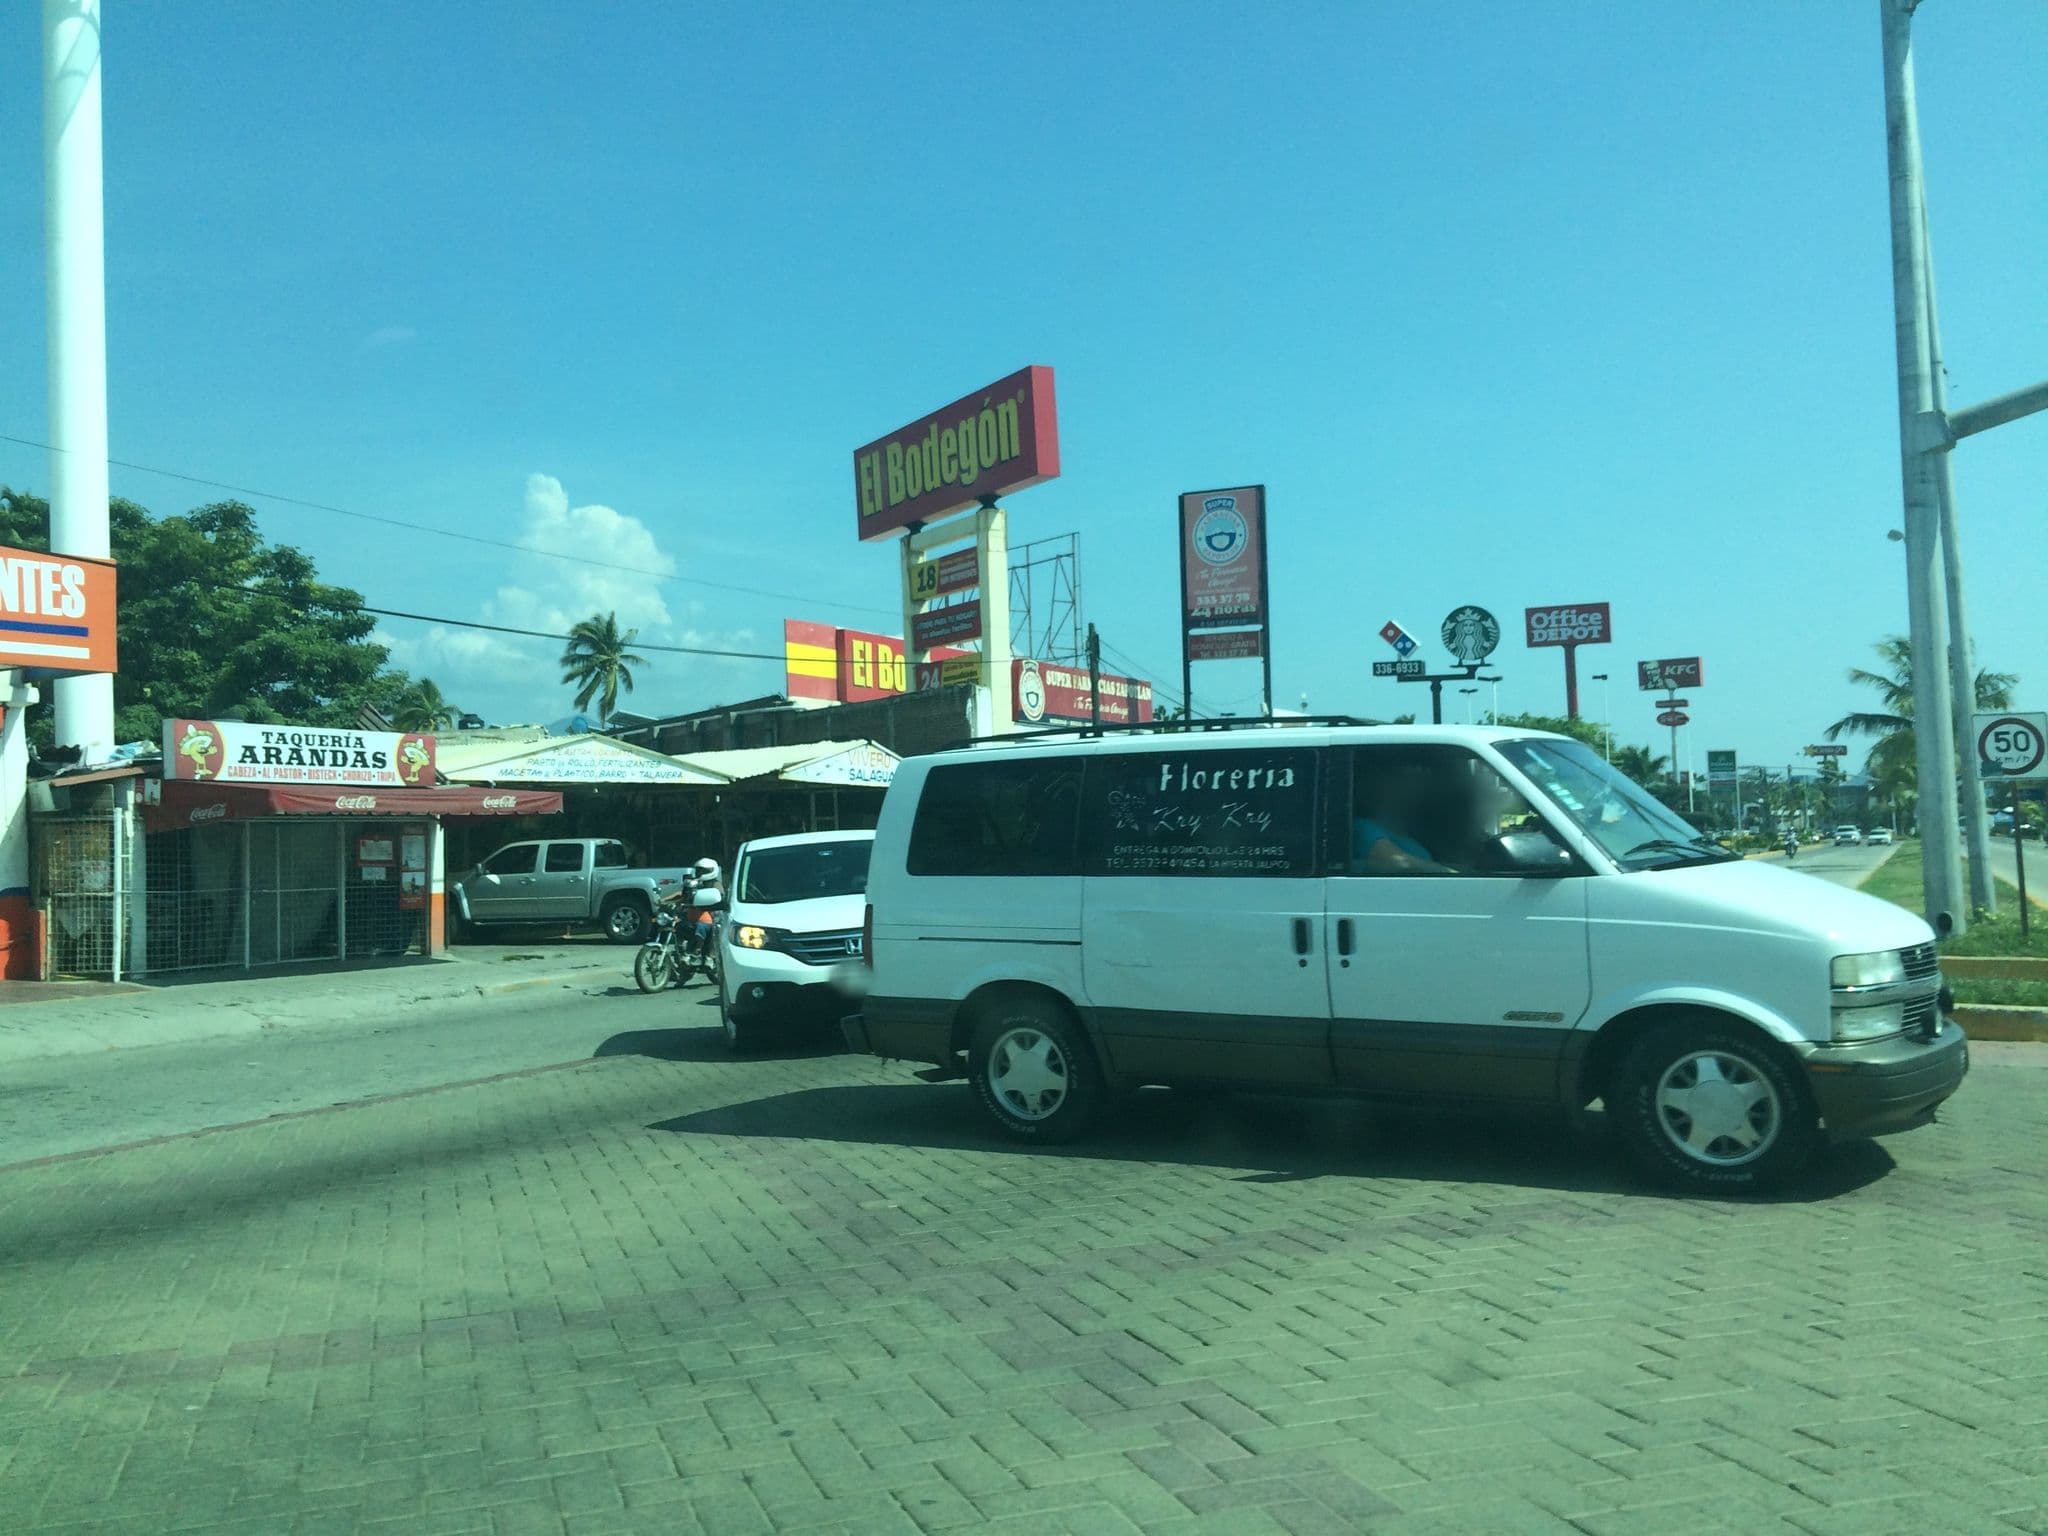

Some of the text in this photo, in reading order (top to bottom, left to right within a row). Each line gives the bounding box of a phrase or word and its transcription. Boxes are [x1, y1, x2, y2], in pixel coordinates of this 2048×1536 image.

[859, 395, 1021, 518] El Bodegón
[0, 556, 87, 619] NTES
[916, 565, 937, 594] 18
[1530, 609, 1603, 630] Office
[1532, 625, 1603, 642] DEPOT
[852, 638, 874, 689] El
[1374, 661, 1420, 675] 336-6933
[1663, 663, 1698, 676] KFC
[1045, 669, 1072, 689] SUPER
[261, 731, 366, 749] TAQUERÍA
[1993, 730, 2031, 753] 50
[238, 745, 388, 769] ARANDAS
[848, 750, 891, 768] VIVERO
[227, 765, 257, 778] CABEZA
[262, 767, 272, 778] AL
[273, 768, 303, 779] PASTOR
[335, 795, 378, 809] Coca-Cola
[483, 795, 517, 809] Coca-Cola
